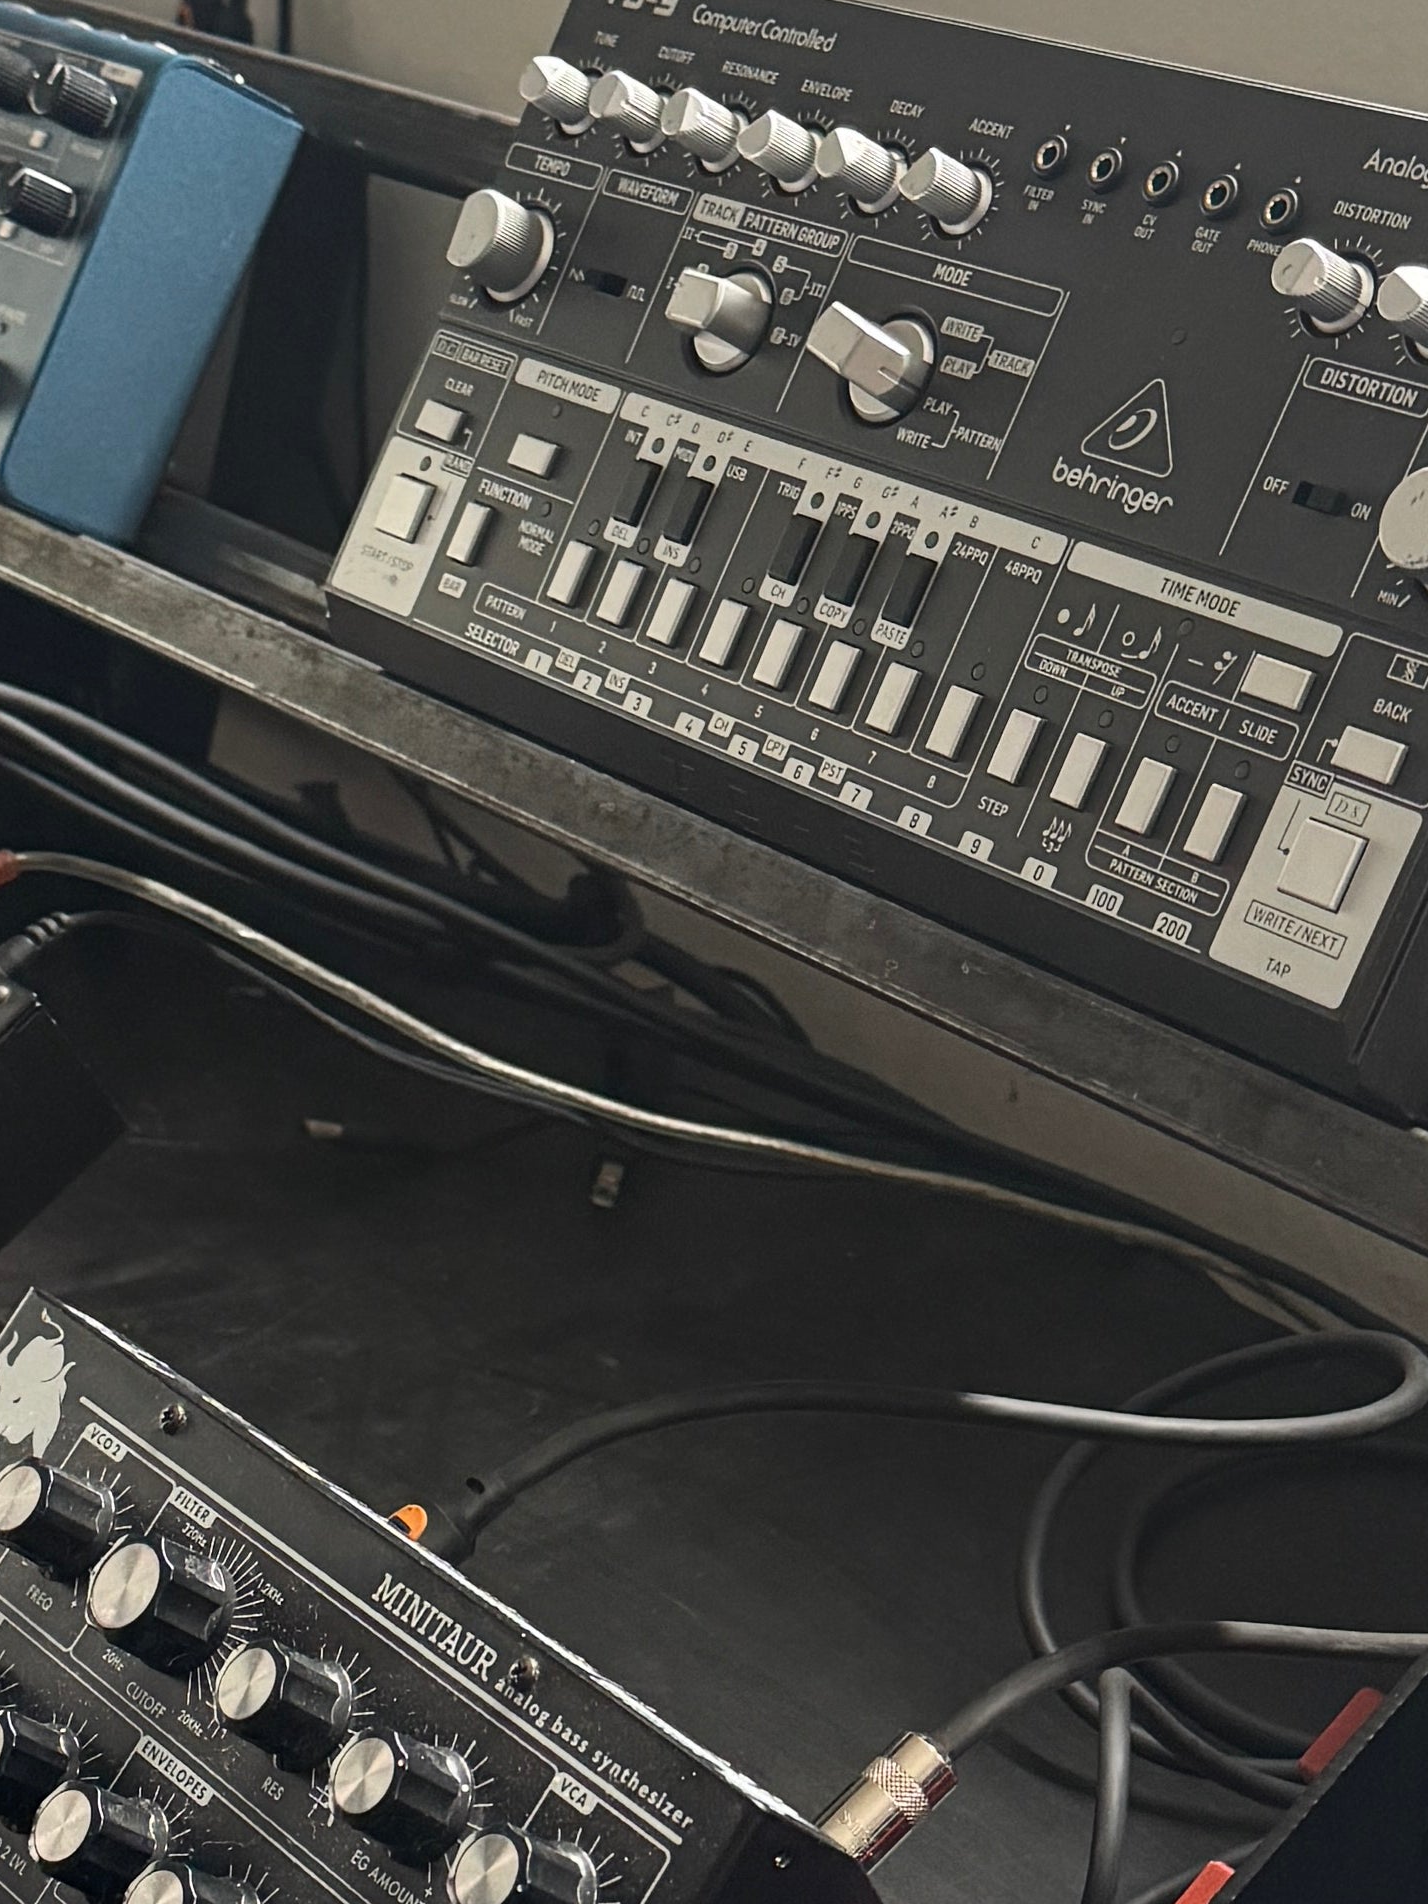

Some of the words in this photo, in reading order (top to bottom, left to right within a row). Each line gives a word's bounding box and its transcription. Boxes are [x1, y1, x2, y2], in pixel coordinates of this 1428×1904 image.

[692, 4, 761, 35] Computer
[761, 19, 838, 52] Controlled
[658, 46, 695, 64] CUTOFF
[722, 60, 779, 85] RESONANCE
[801, 79, 853, 102] ENVELOPE
[889, 99, 925, 118] DECAY
[969, 118, 1013, 139] ACCENT
[534, 154, 572, 177] TEMPO
[617, 178, 680, 207] WAVEFORM
[1024, 185, 1054, 201] FILTER
[700, 200, 740, 223] TRACK
[1081, 199, 1106, 214] SYNC
[1333, 200, 1412, 230] DISTORTION
[743, 211, 799, 240] PATTERN
[797, 227, 841, 250] GROUP
[1134, 226, 1155, 240] OUT
[1195, 227, 1220, 242] GATE
[1191, 240, 1213, 254] OUT
[1246, 239, 1282, 256] PHONE
[932, 263, 973, 287] MODE
[944, 319, 981, 339] WRITE
[943, 358, 973, 376] PLAY
[993, 353, 1032, 375] TRACK
[445, 377, 474, 397] CLEAR
[537, 369, 571, 391] PITCH
[570, 379, 602, 402] MODE
[1320, 367, 1419, 408] DISTORTION
[923, 396, 953, 416] PLAY
[896, 426, 931, 449] WRITE
[955, 427, 1002, 452] PATTERN
[478, 479, 532, 511] FUNCTION
[1051, 456, 1174, 516] behringer
[1263, 476, 1290, 496] OFF
[625, 430, 643, 445] INT
[726, 464, 748, 482] USB
[777, 482, 801, 500] TRIG
[952, 542, 989, 566] 24PPQ
[1004, 560, 1043, 585] 48PPQ
[1351, 502, 1372, 522] ON
[518, 520, 555, 544] NORMAL
[1031, 536, 1041, 549] C
[771, 585, 786, 600] CH
[1160, 577, 1197, 603] TIME
[1197, 593, 1241, 618] MODE
[1377, 589, 1400, 607] MIN
[820, 604, 847, 622] COPY
[875, 624, 906, 645] PASTE
[1039, 659, 1069, 678] DOWN
[1066, 648, 1122, 678] TRANSPOSE
[485, 594, 526, 620] PATTERN
[754, 705, 764, 718] 5
[868, 751, 877, 764] 7
[1111, 686, 1125, 698] UP
[1166, 694, 1219, 723] ACCENT
[1373, 698, 1412, 723] BACK
[1239, 720, 1278, 745] SLIDE
[464, 622, 520, 656] SELECTOR
[582, 676, 592, 690] 2
[632, 697, 641, 711] 3
[684, 718, 693, 732] 4
[738, 741, 747, 756] 5
[792, 764, 803, 779] 6
[822, 760, 844, 780] PST
[851, 788, 861, 803] 7
[909, 813, 920, 829] 8
[970, 838, 982, 854] 9
[1091, 888, 1117, 912] 100
[1156, 916, 1187, 942] 200
[1290, 766, 1330, 792] SYNC
[977, 796, 1009, 817] STEP
[1109, 859, 1154, 890] PATTERN
[1155, 877, 1198, 904] SECTION
[1266, 957, 1292, 978] TAP
[91, 1426, 115, 1451] VCO
[175, 1490, 210, 1524] FILTER
[25, 1584, 54, 1612] FREQ
[125, 1681, 166, 1719] CUTOFF
[371, 1573, 498, 1682] MINITAUR
[494, 1676, 551, 1730] analog
[551, 1718, 588, 1754] bass
[591, 1750, 694, 1829] synthesizer
[142, 1740, 207, 1800] ENVELOPES
[261, 1776, 285, 1801] RES
[558, 1777, 587, 1809] VCA
[9, 1854, 27, 1876] LVL
[350, 1849, 371, 1872] EG
